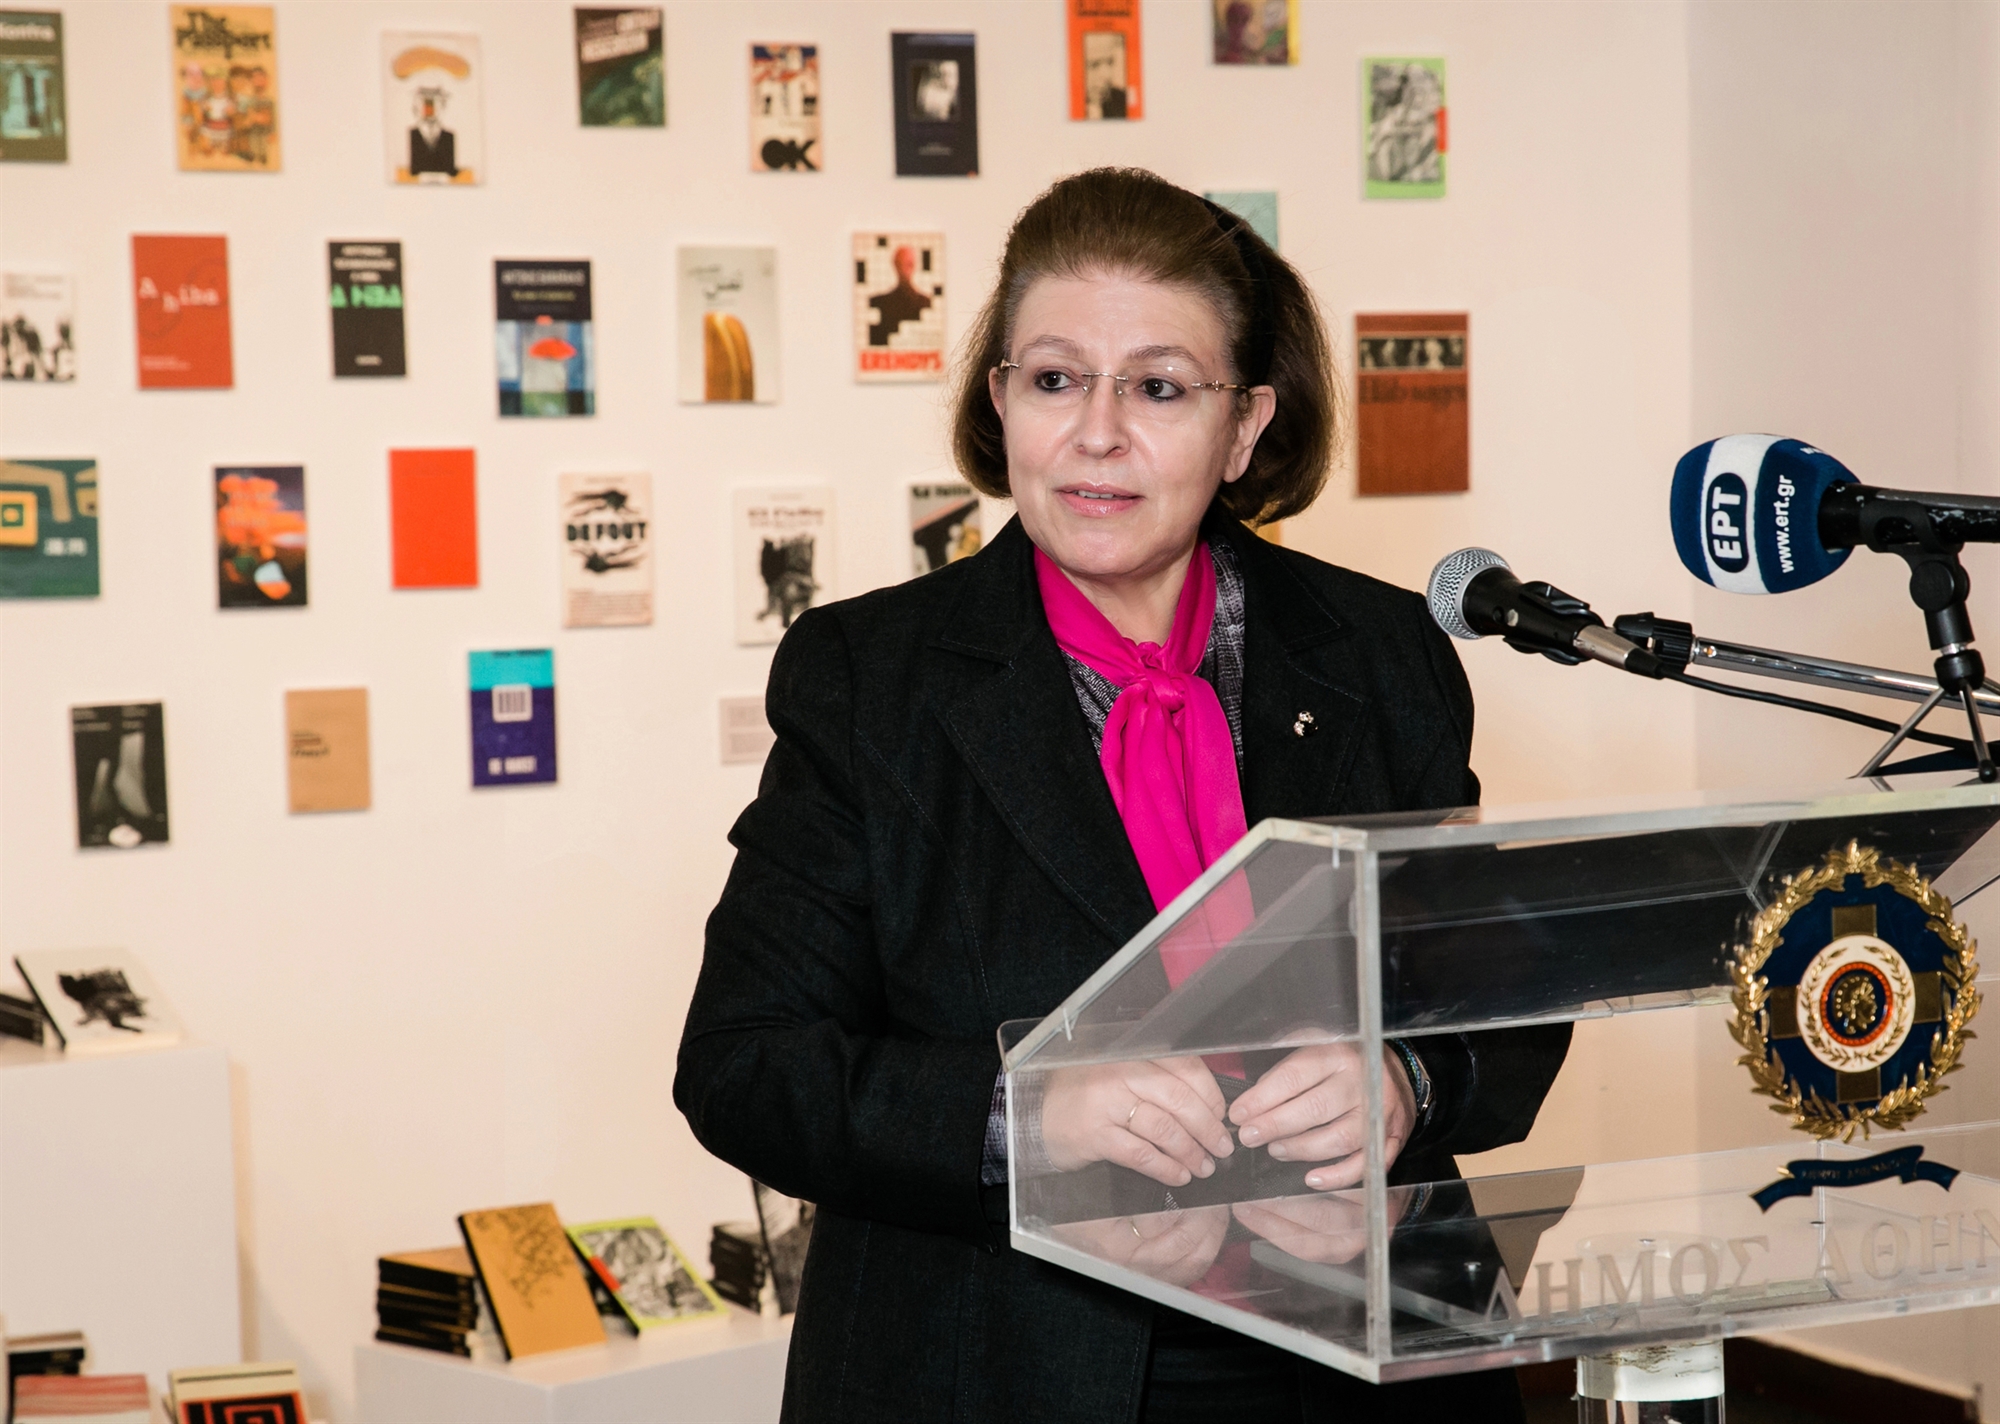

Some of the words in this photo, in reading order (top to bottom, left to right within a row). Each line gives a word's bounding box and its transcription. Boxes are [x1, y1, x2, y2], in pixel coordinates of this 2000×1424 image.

[175, 28, 271, 60] Passport
[1773, 475, 1796, 574] www.ert.gr
[1484, 1235, 1770, 1323] ΔΗΜΟΣ
